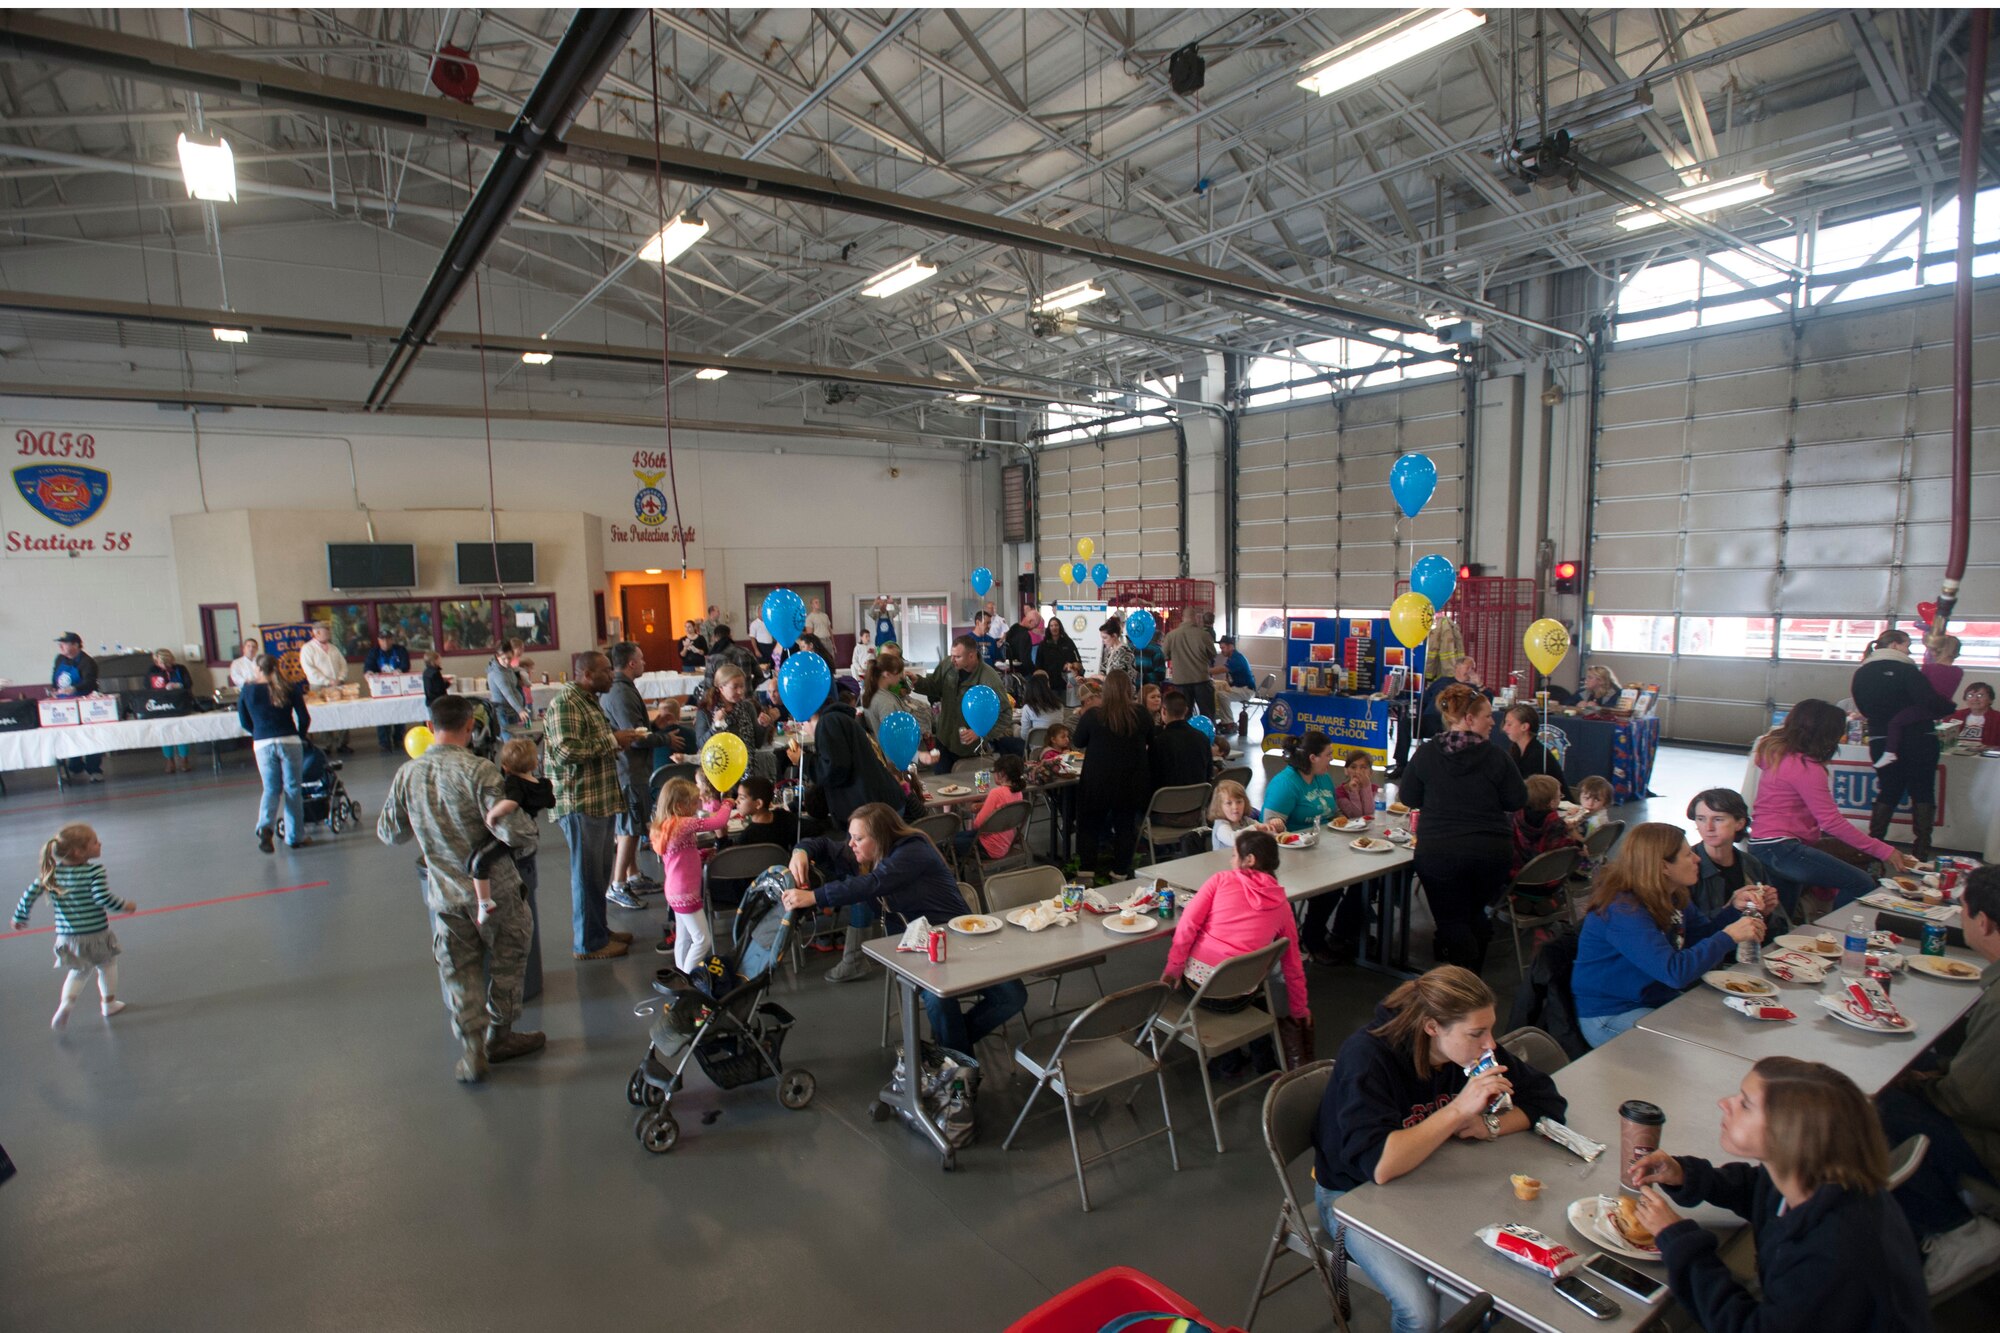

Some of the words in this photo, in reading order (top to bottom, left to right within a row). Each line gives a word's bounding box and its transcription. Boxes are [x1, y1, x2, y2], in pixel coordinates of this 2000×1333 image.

[15, 429, 95, 459] DAFB
[632, 450, 667, 469] 436th
[6, 531, 95, 552] Station
[103, 532, 132, 551] 58
[611, 524, 628, 542] Fire
[630, 524, 669, 543] Protection
[672, 525, 695, 547] Flght
[1297, 712, 1346, 727] DELAWARE
[1349, 719, 1378, 731] STATE
[1305, 723, 1325, 734] FIRE
[1328, 726, 1368, 740] SCHOOL
